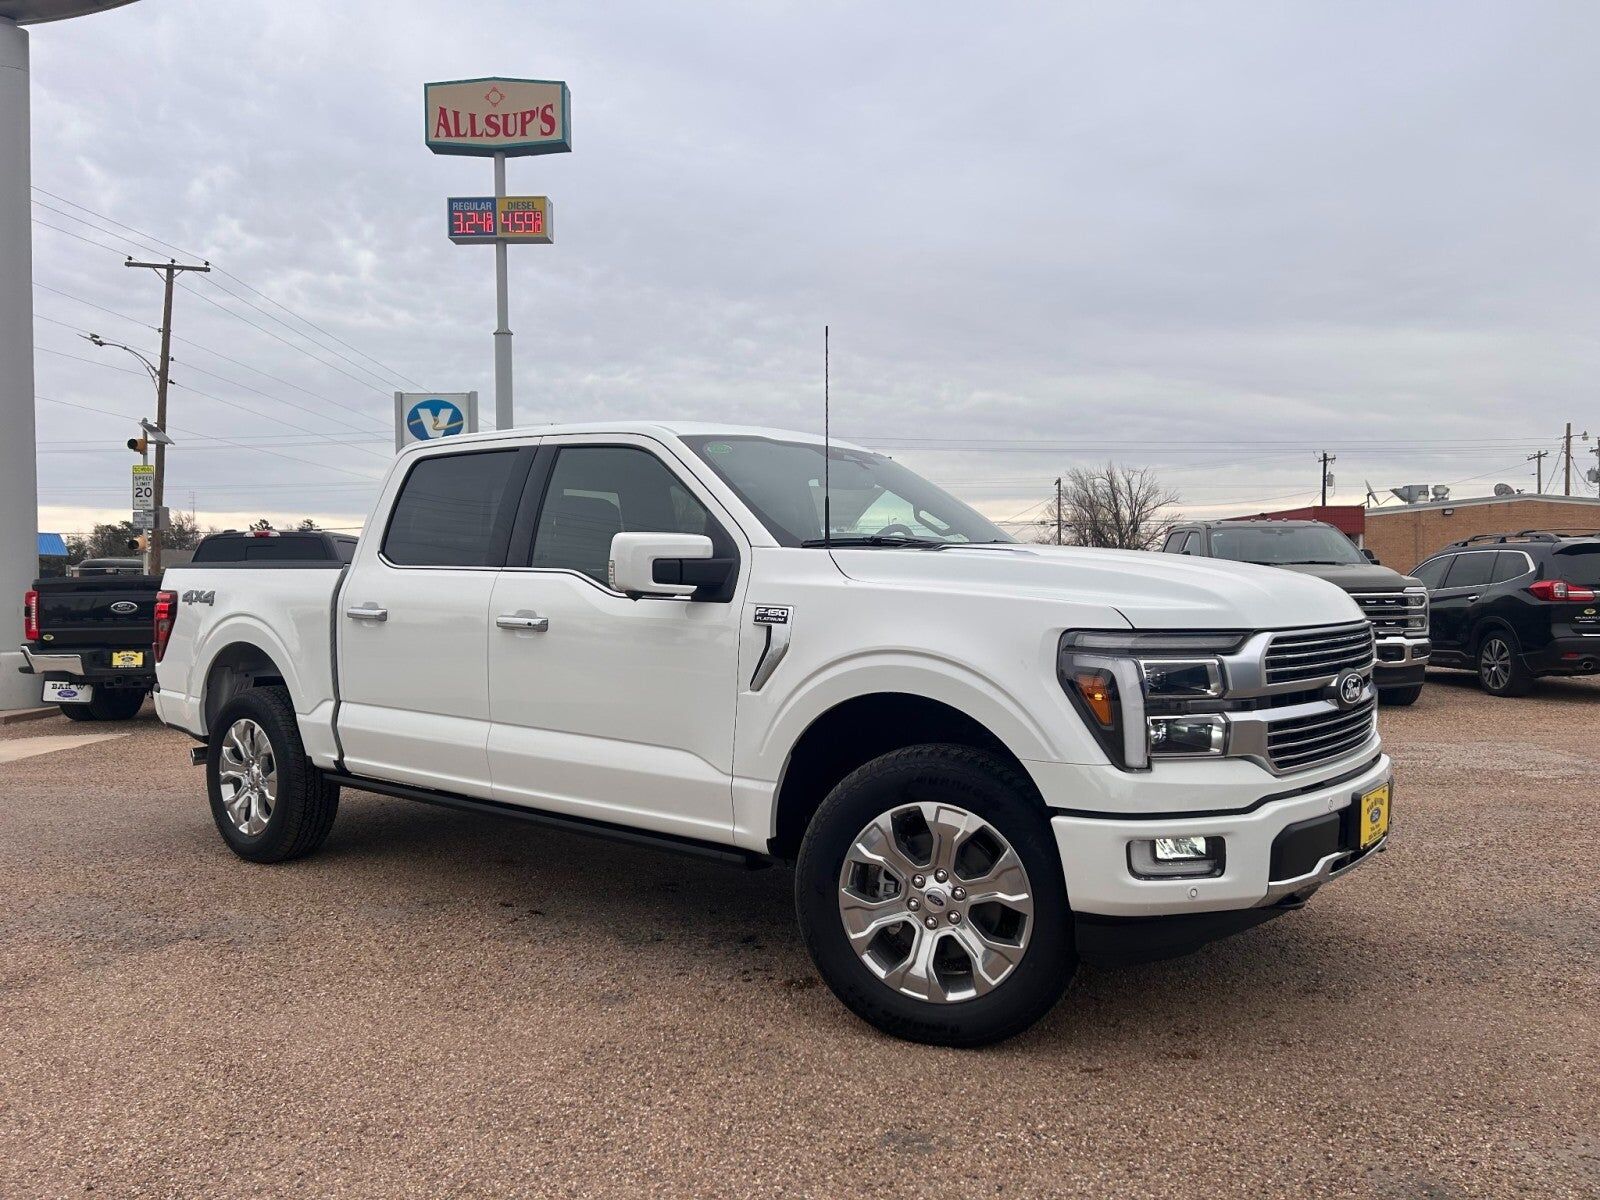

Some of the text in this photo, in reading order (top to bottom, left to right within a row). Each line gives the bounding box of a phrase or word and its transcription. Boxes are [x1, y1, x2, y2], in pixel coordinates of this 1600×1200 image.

[434, 104, 556, 138] ALLSUP'S
[452, 201, 492, 211] REGULAR
[507, 201, 537, 210] DIESEL
[135, 487, 153, 498] 20
[755, 608, 788, 617] F-150
[1345, 678, 1361, 700] Ford
